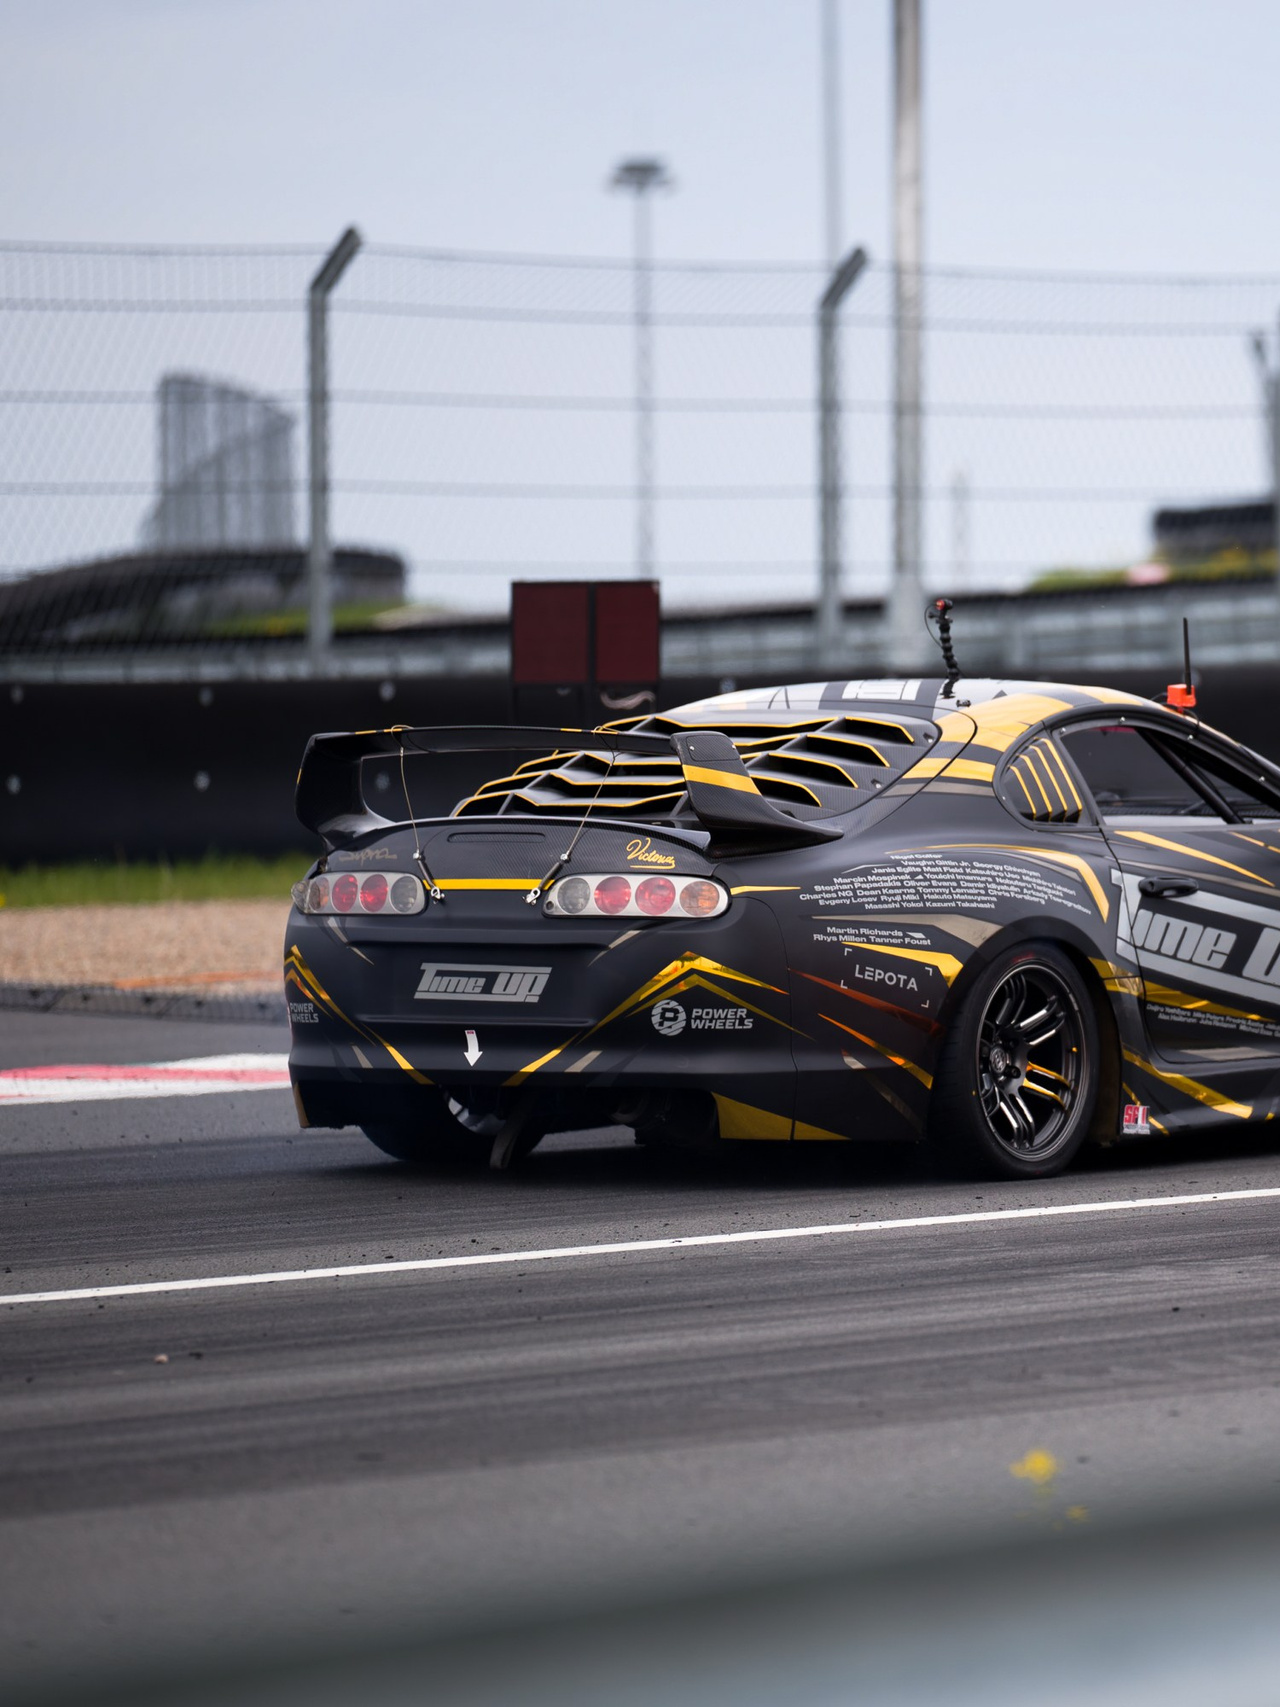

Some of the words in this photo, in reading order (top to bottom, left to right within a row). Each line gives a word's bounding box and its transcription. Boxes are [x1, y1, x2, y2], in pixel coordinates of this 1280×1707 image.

[833, 876, 867, 884] Marcin
[814, 884, 853, 892] Stephan
[854, 881, 901, 890] Papadakis
[799, 893, 837, 901] Charles
[917, 887, 949, 895] Tommy
[988, 889, 1010, 898] Chris
[826, 926, 859, 934] Martin
[859, 927, 903, 937] Richards
[813, 934, 838, 942] Rhys
[838, 935, 867, 943] Millen
[869, 936, 904, 944] Tanner
[904, 937, 931, 945] Foust
[854, 964, 918, 991] LEPOTA
[691, 1008, 747, 1019] POWER
[690, 1019, 753, 1029] WHEELS
